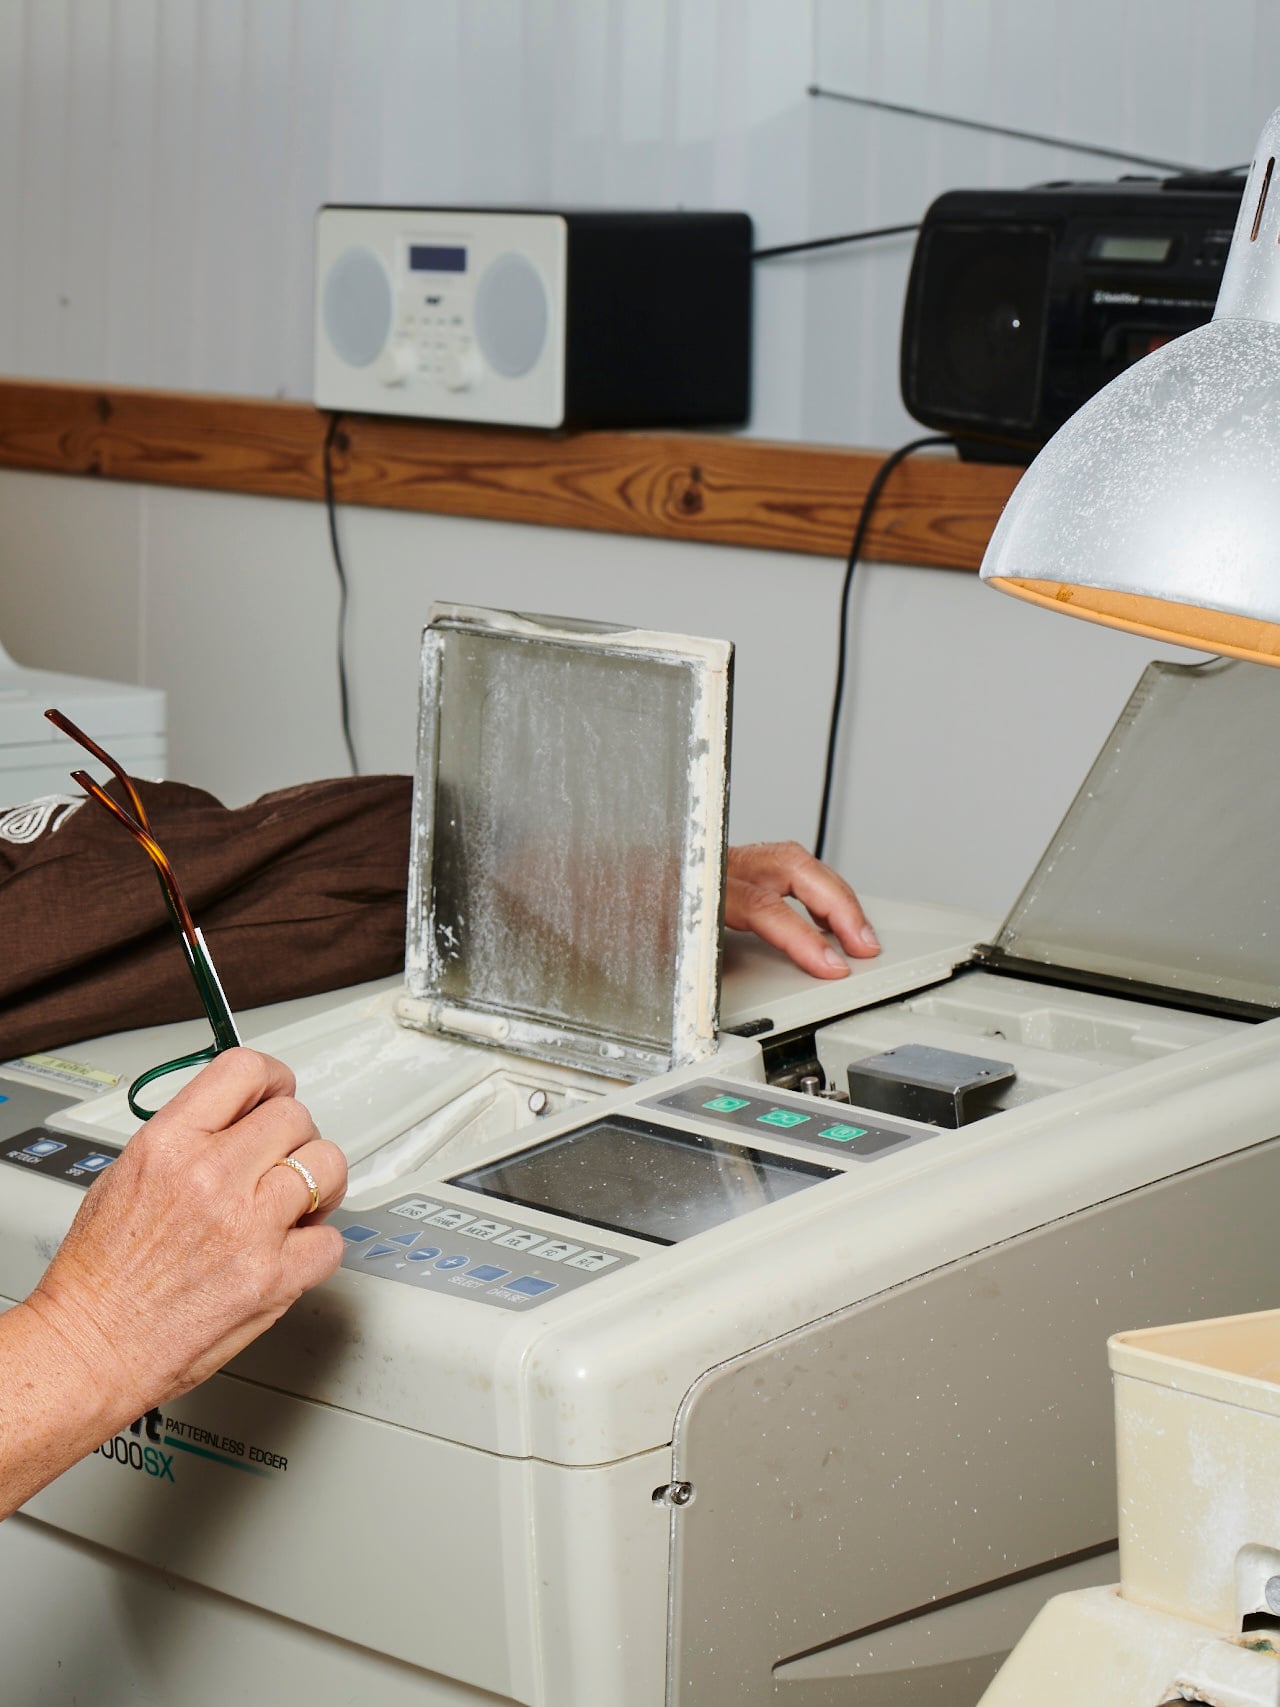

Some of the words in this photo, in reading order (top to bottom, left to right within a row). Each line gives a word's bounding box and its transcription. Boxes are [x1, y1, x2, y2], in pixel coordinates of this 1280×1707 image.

[6, 1150, 42, 1164] RETOUCH
[396, 1206, 422, 1216] LENS
[431, 1216, 457, 1228] FRAME
[465, 1227, 493, 1238] MODE
[448, 1275, 482, 1289] SELECT
[166, 1417, 245, 1457] PATTERNLESS
[249, 1447, 288, 1472] EDGER
[93, 1436, 176, 1483] 000SX
